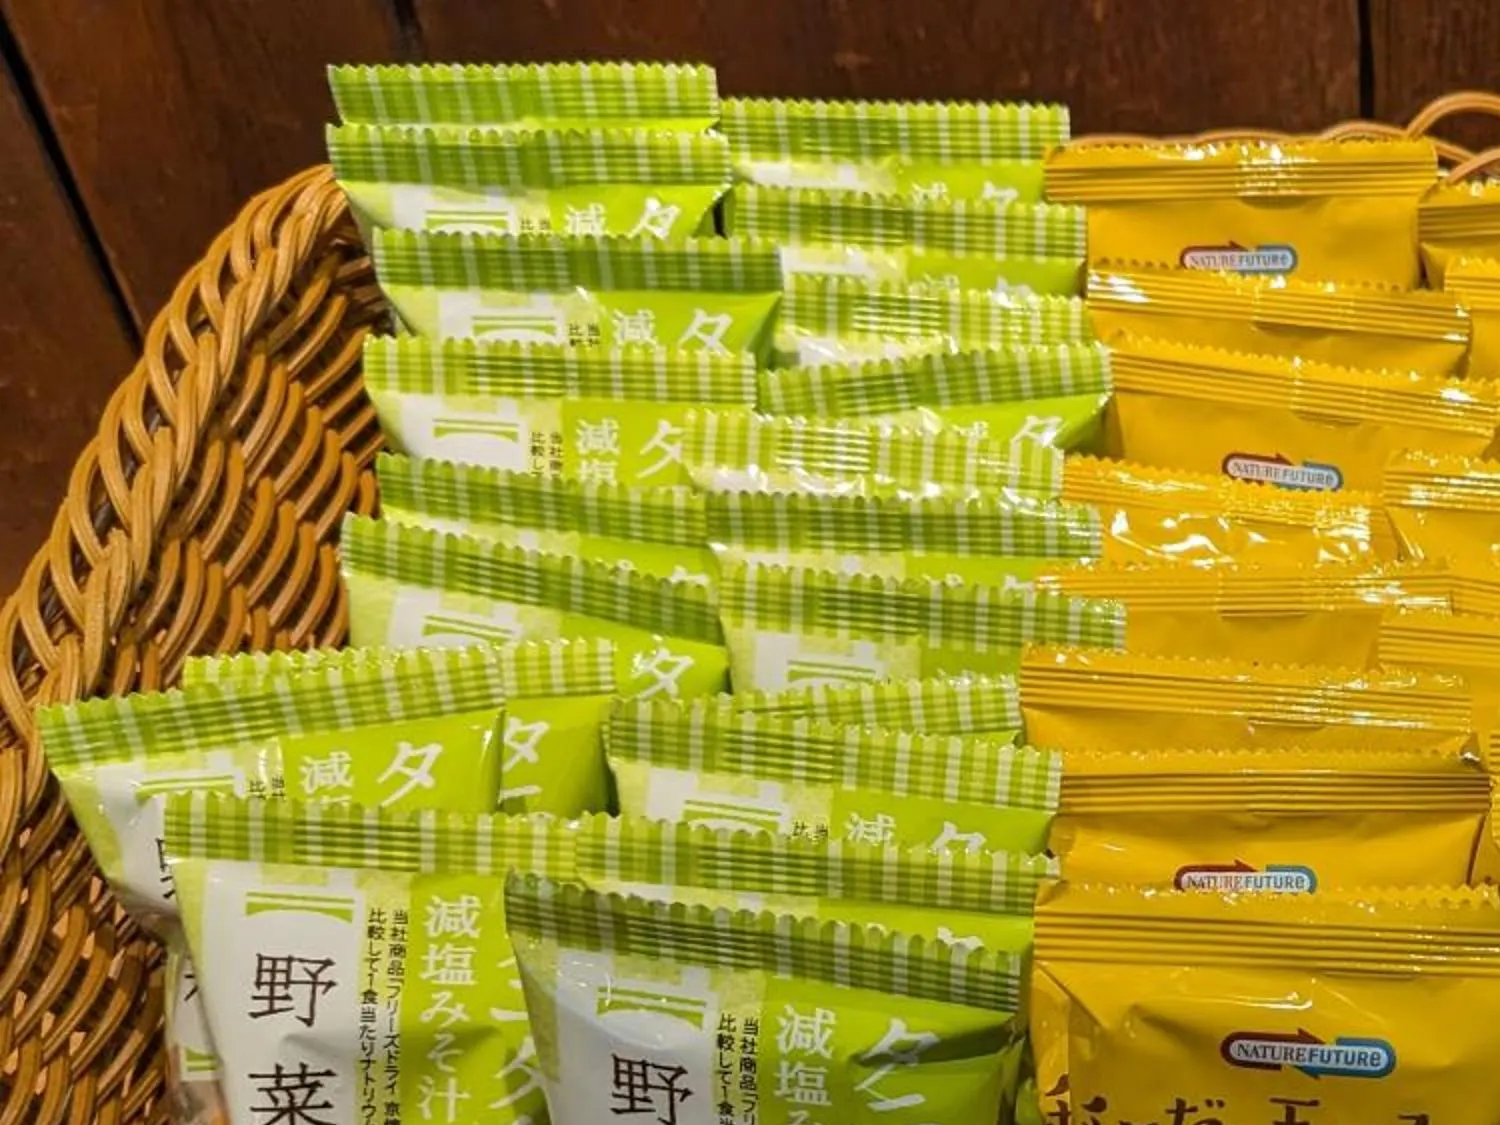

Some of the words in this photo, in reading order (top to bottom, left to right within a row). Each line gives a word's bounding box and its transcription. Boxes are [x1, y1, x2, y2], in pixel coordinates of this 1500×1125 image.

[417, 894, 482, 1123] 減塩みそ汁
